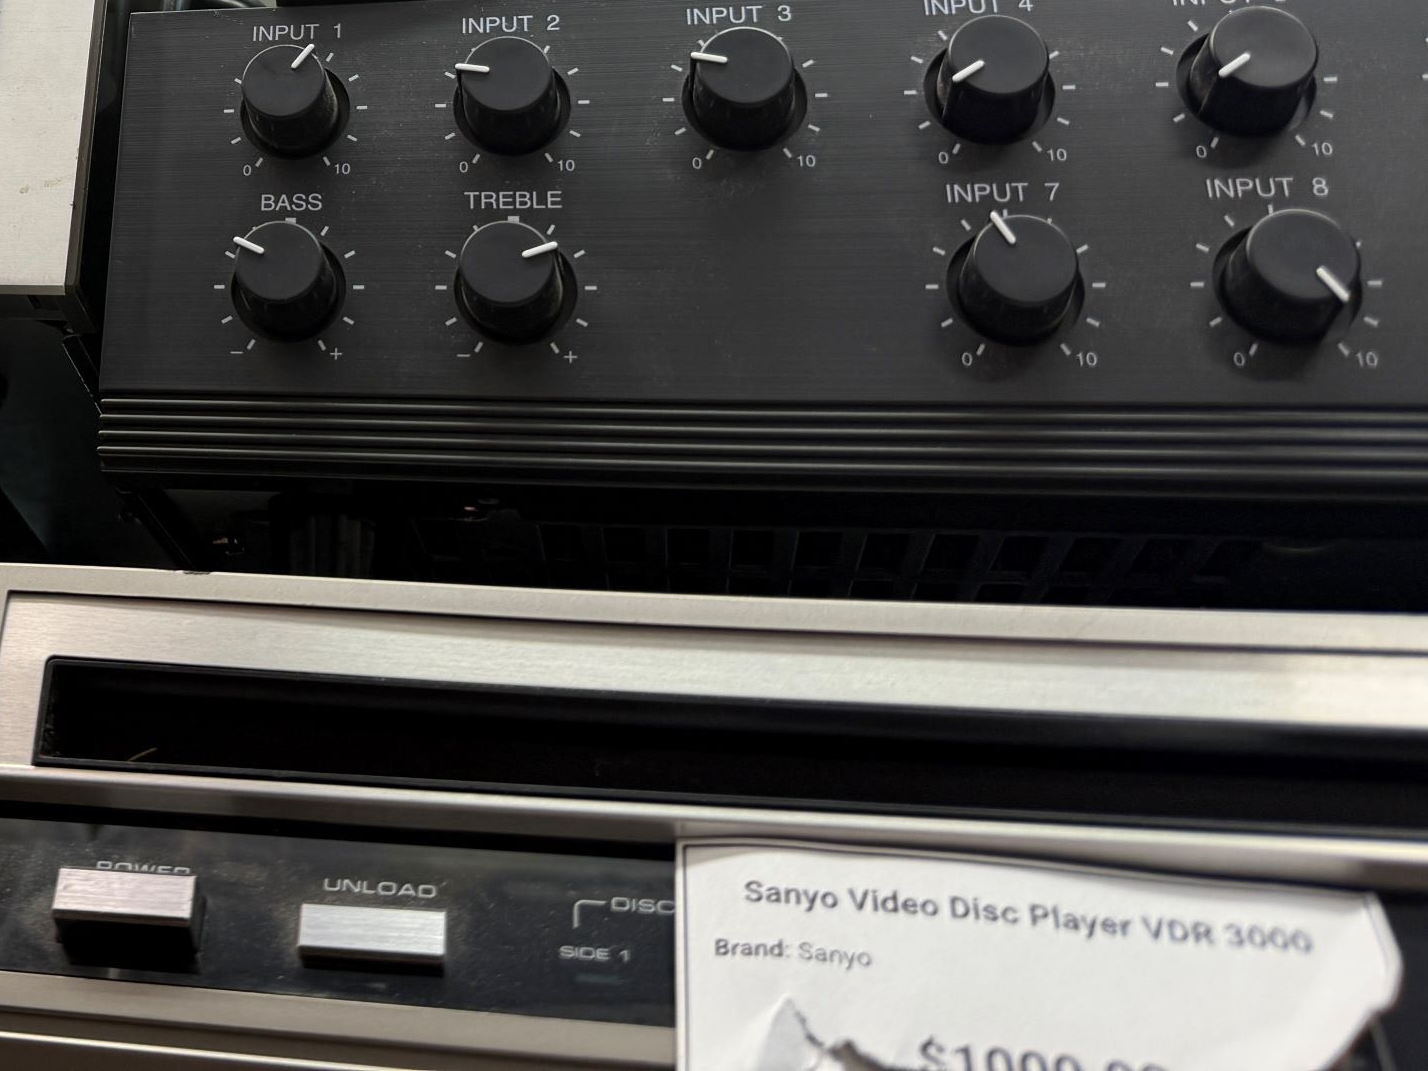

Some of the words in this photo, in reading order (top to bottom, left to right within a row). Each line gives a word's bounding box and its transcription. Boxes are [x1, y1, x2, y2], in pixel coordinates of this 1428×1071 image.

[461, 15, 535, 35] INPUT
[547, 14, 561, 32] 2
[686, 6, 763, 26] INPUT
[777, 4, 792, 22] 3
[252, 23, 320, 42] INPUT
[332, 23, 342, 40] 1
[945, 182, 1029, 204] INPUT
[1044, 183, 1060, 202] 7
[1206, 178, 1294, 199] INPUT
[260, 193, 323, 213] BASS
[464, 191, 563, 210] TREBLE
[323, 876, 439, 899] UNLOAD
[743, 879, 840, 913] Sanyo
[847, 887, 940, 919] Video
[950, 896, 1022, 926] Disc
[1031, 903, 1133, 940] Player
[1141, 916, 1217, 945] VDR
[1224, 923, 1315, 955] 3000
[558, 944, 611, 962] SIDE
[619, 949, 631, 963] 1
[714, 937, 792, 961] Brand:
[798, 940, 873, 969] Sanyo
